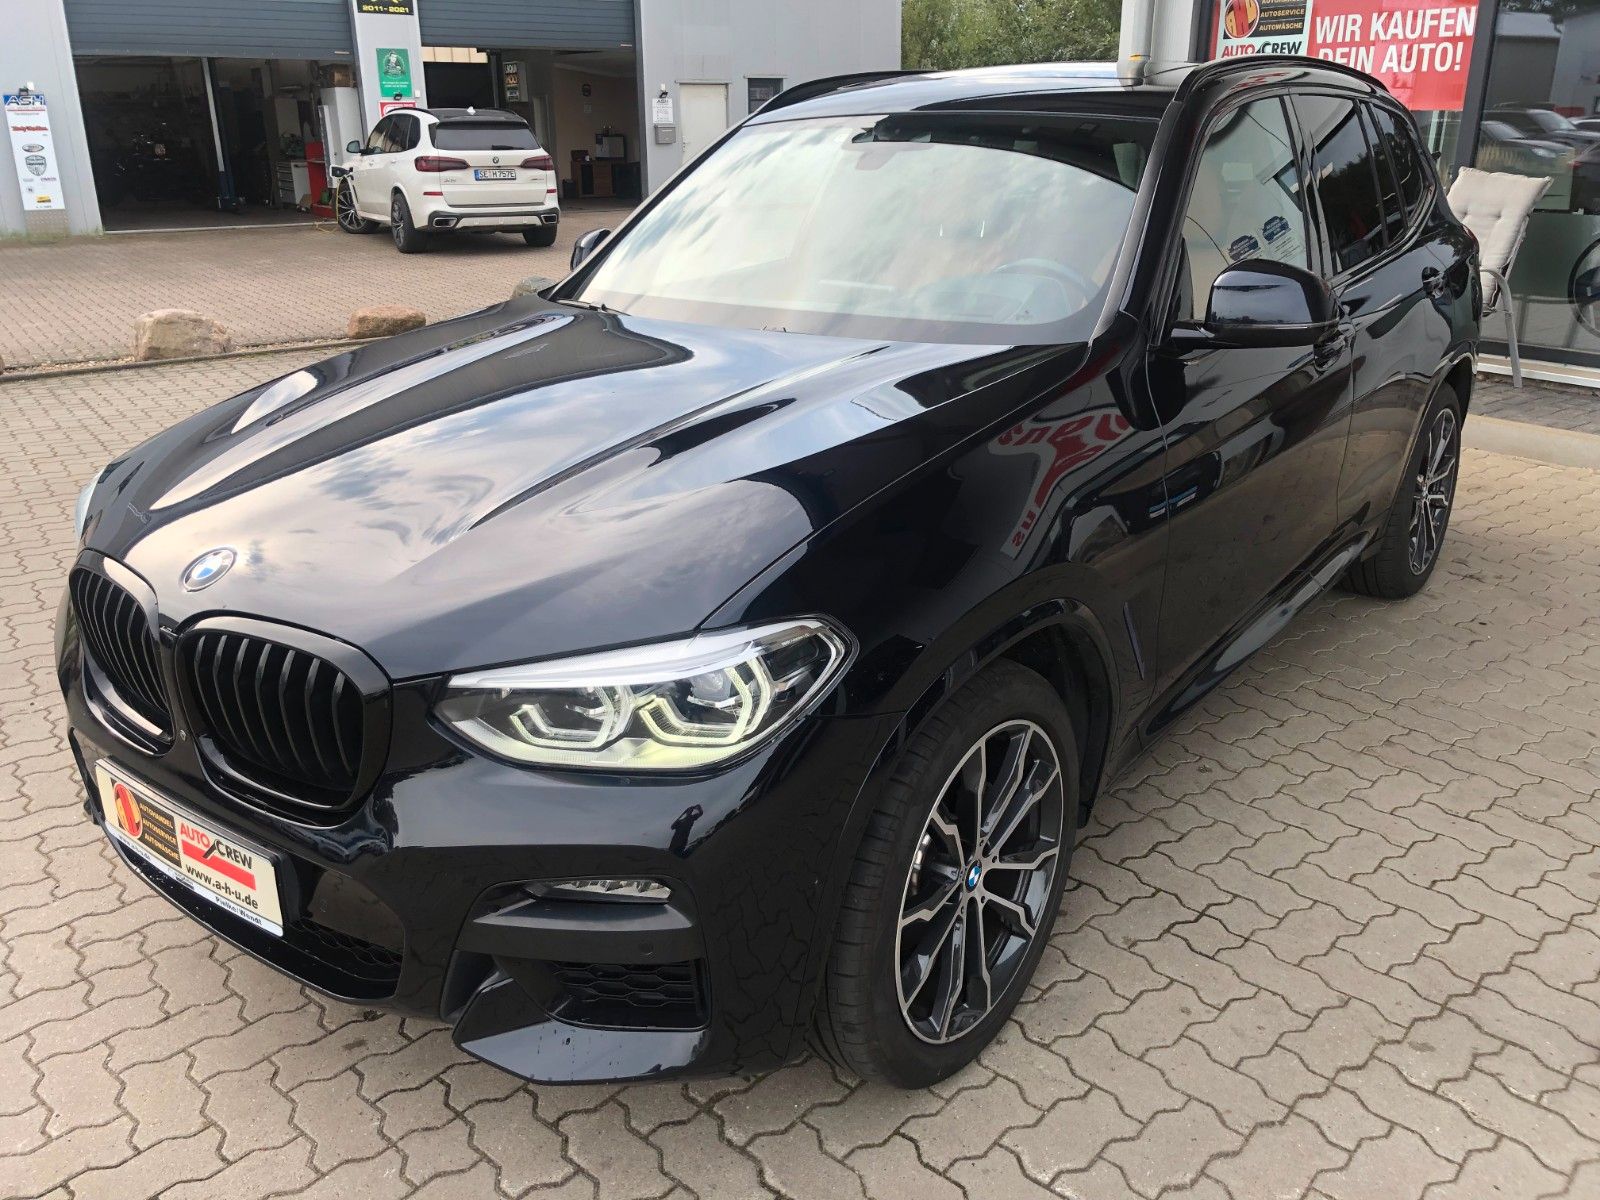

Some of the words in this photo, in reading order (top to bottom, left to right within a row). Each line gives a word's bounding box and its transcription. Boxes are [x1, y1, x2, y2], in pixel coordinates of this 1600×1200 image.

[1260, 9, 1305, 18] AUTOSERVICE
[1316, 14, 1362, 44] WIR
[1369, 6, 1477, 41] KAUFEN
[1380, 42, 1464, 73] AUTO!
[6, 95, 46, 106] ASH
[180, 823, 211, 849] AUTO
[216, 839, 253, 869] CREW
[185, 863, 259, 909] www.a-h-u.de
